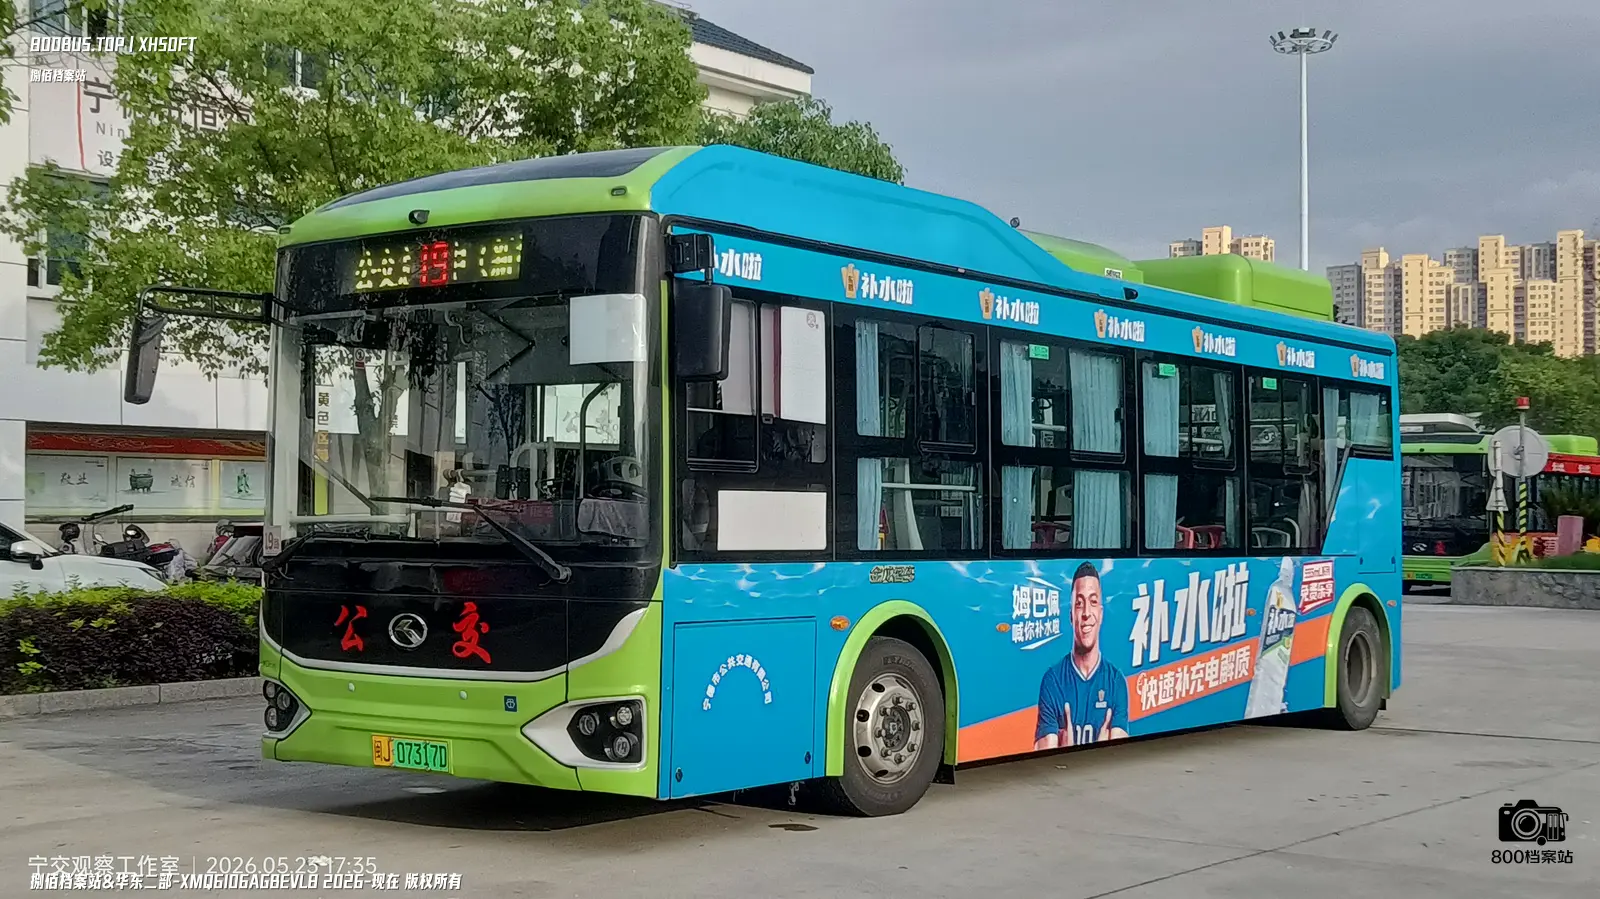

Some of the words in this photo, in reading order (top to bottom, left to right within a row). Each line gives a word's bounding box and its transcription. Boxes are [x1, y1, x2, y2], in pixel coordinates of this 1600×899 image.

[420, 240, 449, 288] 19
[714, 245, 763, 281] 水啦
[861, 272, 914, 305] 补水啦
[995, 295, 1040, 325] 补水啦
[1107, 315, 1145, 342] 补水啦
[1203, 332, 1236, 357] 补水啦
[1012, 584, 1060, 620] 姆巴佩
[1129, 562, 1249, 668] 补水啦
[334, 605, 367, 651] 公
[453, 602, 492, 664] 交
[1012, 618, 1061, 643] 喊你补水啦
[1140, 645, 1251, 711] 快速补充电解质
